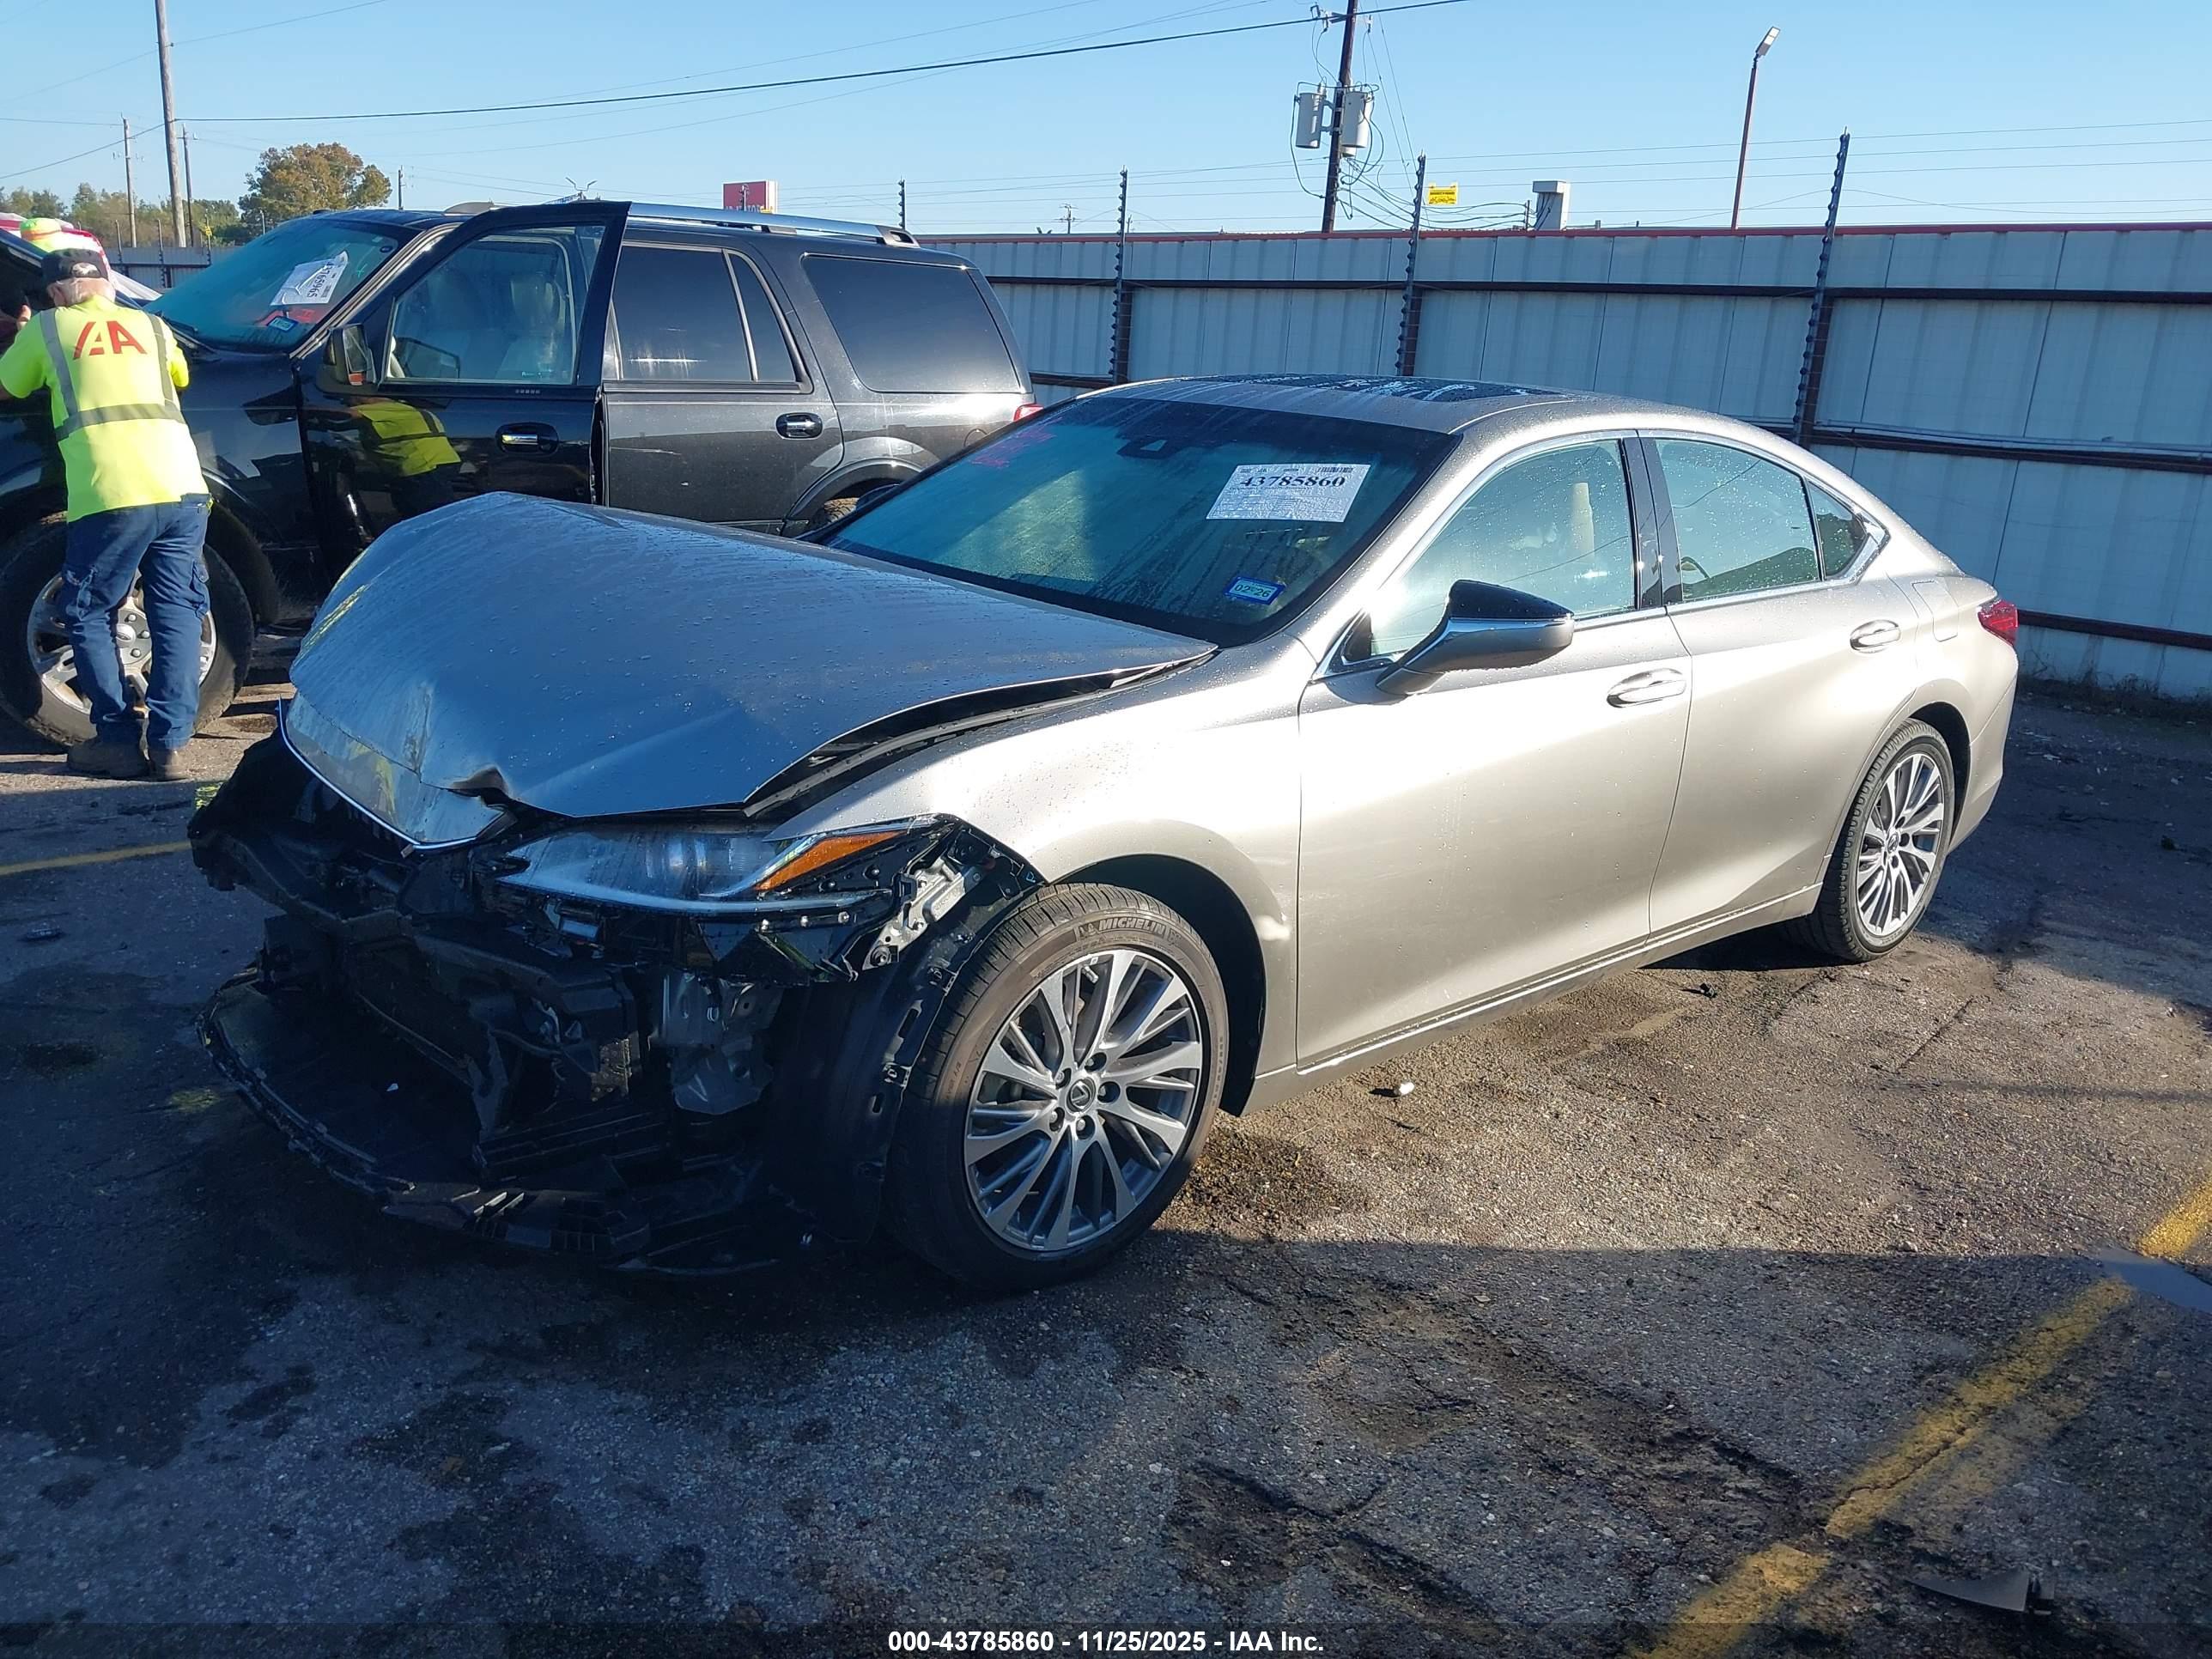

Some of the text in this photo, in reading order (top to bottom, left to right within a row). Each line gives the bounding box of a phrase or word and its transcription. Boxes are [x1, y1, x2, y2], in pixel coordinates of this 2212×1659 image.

[1239, 476, 1346, 487] 43785860
[1234, 584, 1251, 593] 02
[1254, 588, 1272, 598] 26
[1098, 916, 1167, 936] MICHELIN
